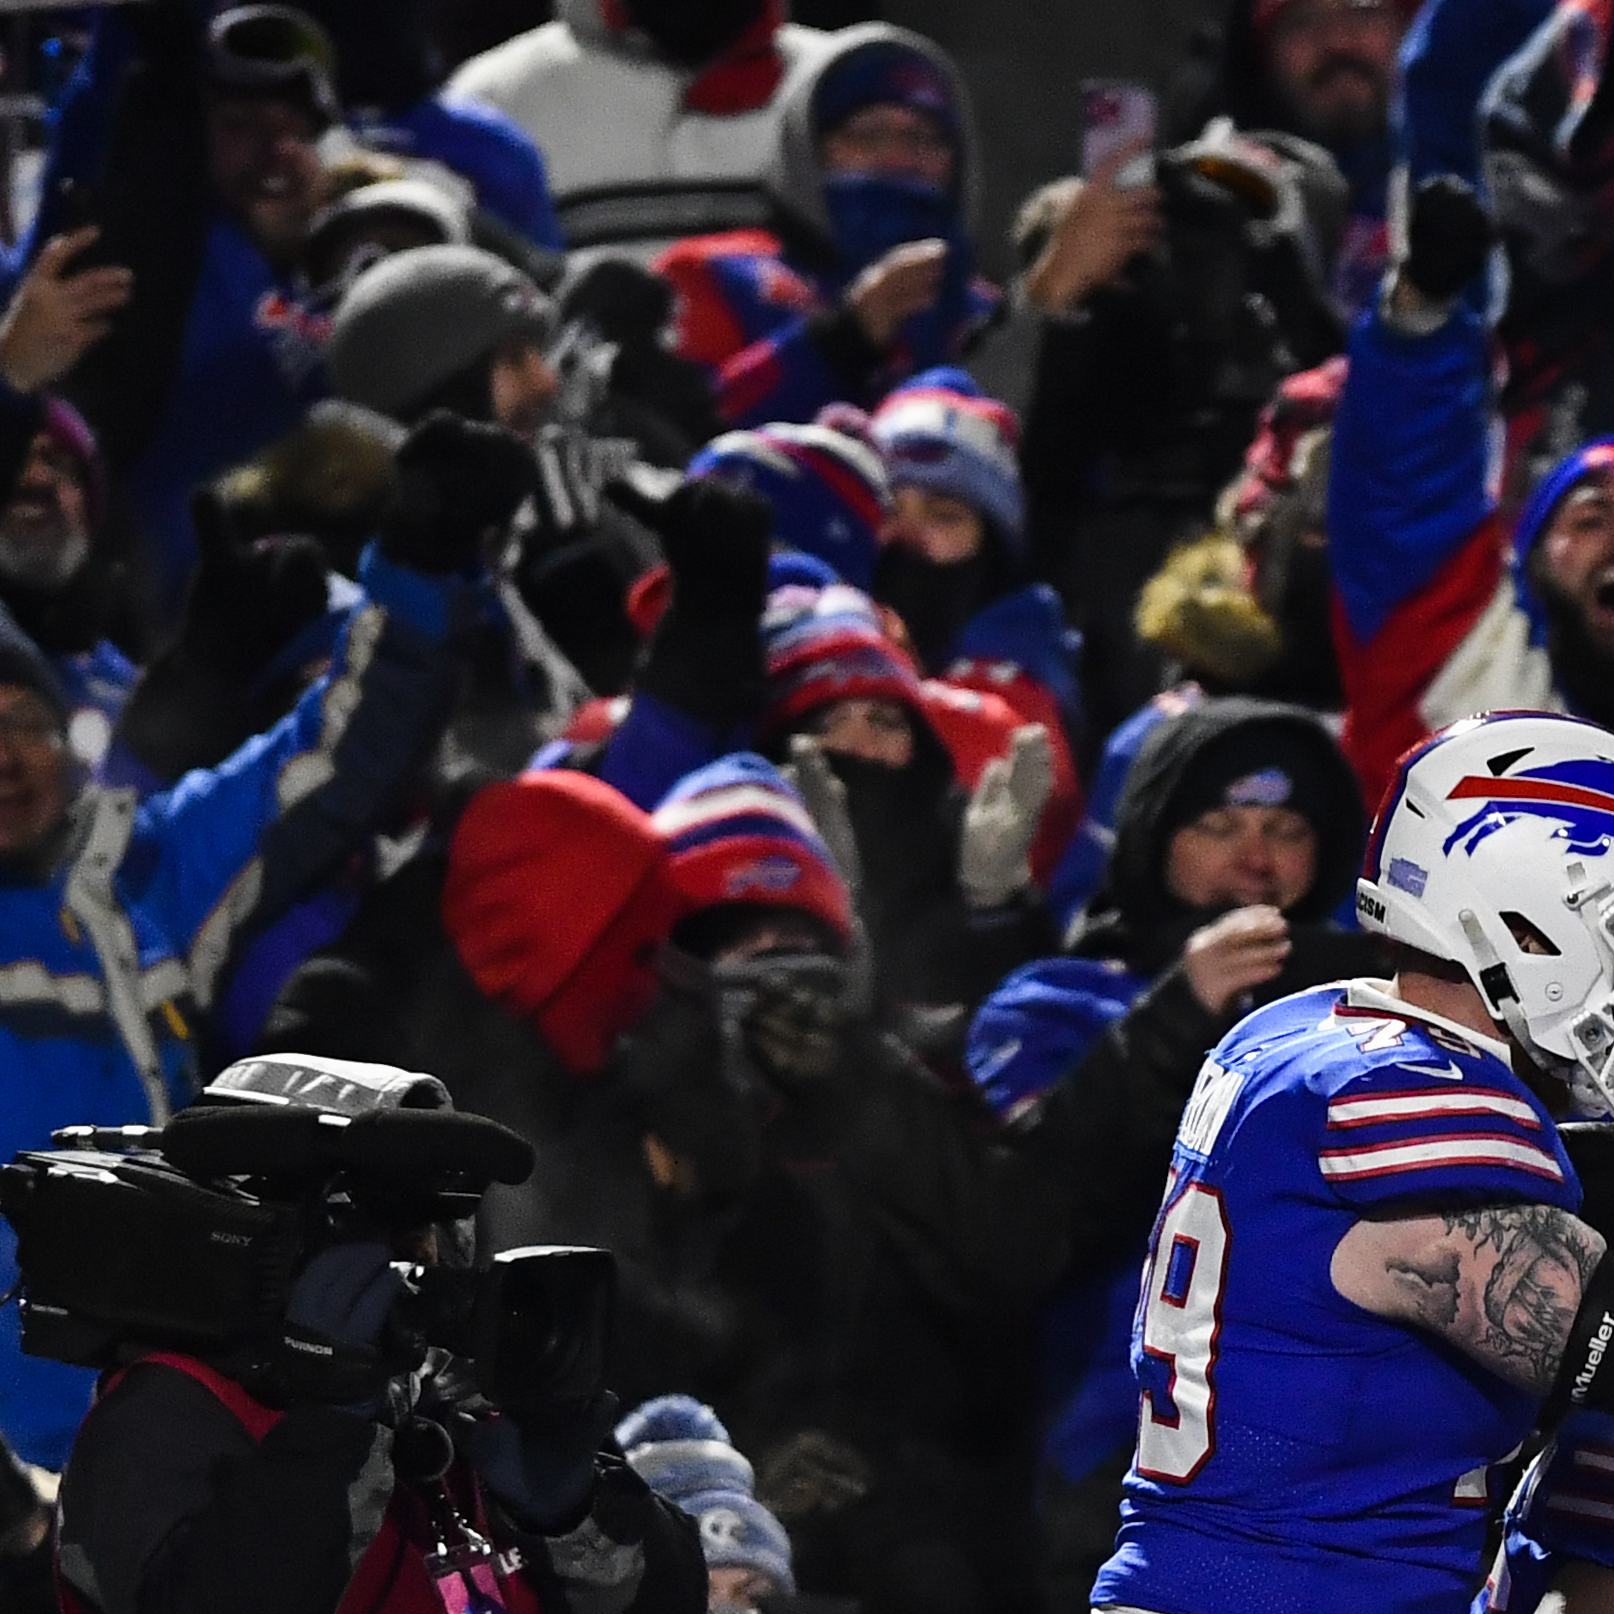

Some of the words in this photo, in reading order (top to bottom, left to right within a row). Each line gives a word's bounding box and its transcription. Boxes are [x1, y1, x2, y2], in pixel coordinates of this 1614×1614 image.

[1357, 891, 1387, 924] CISM
[210, 1231, 254, 1247] SONY
[1135, 1168, 1233, 1487] 9
